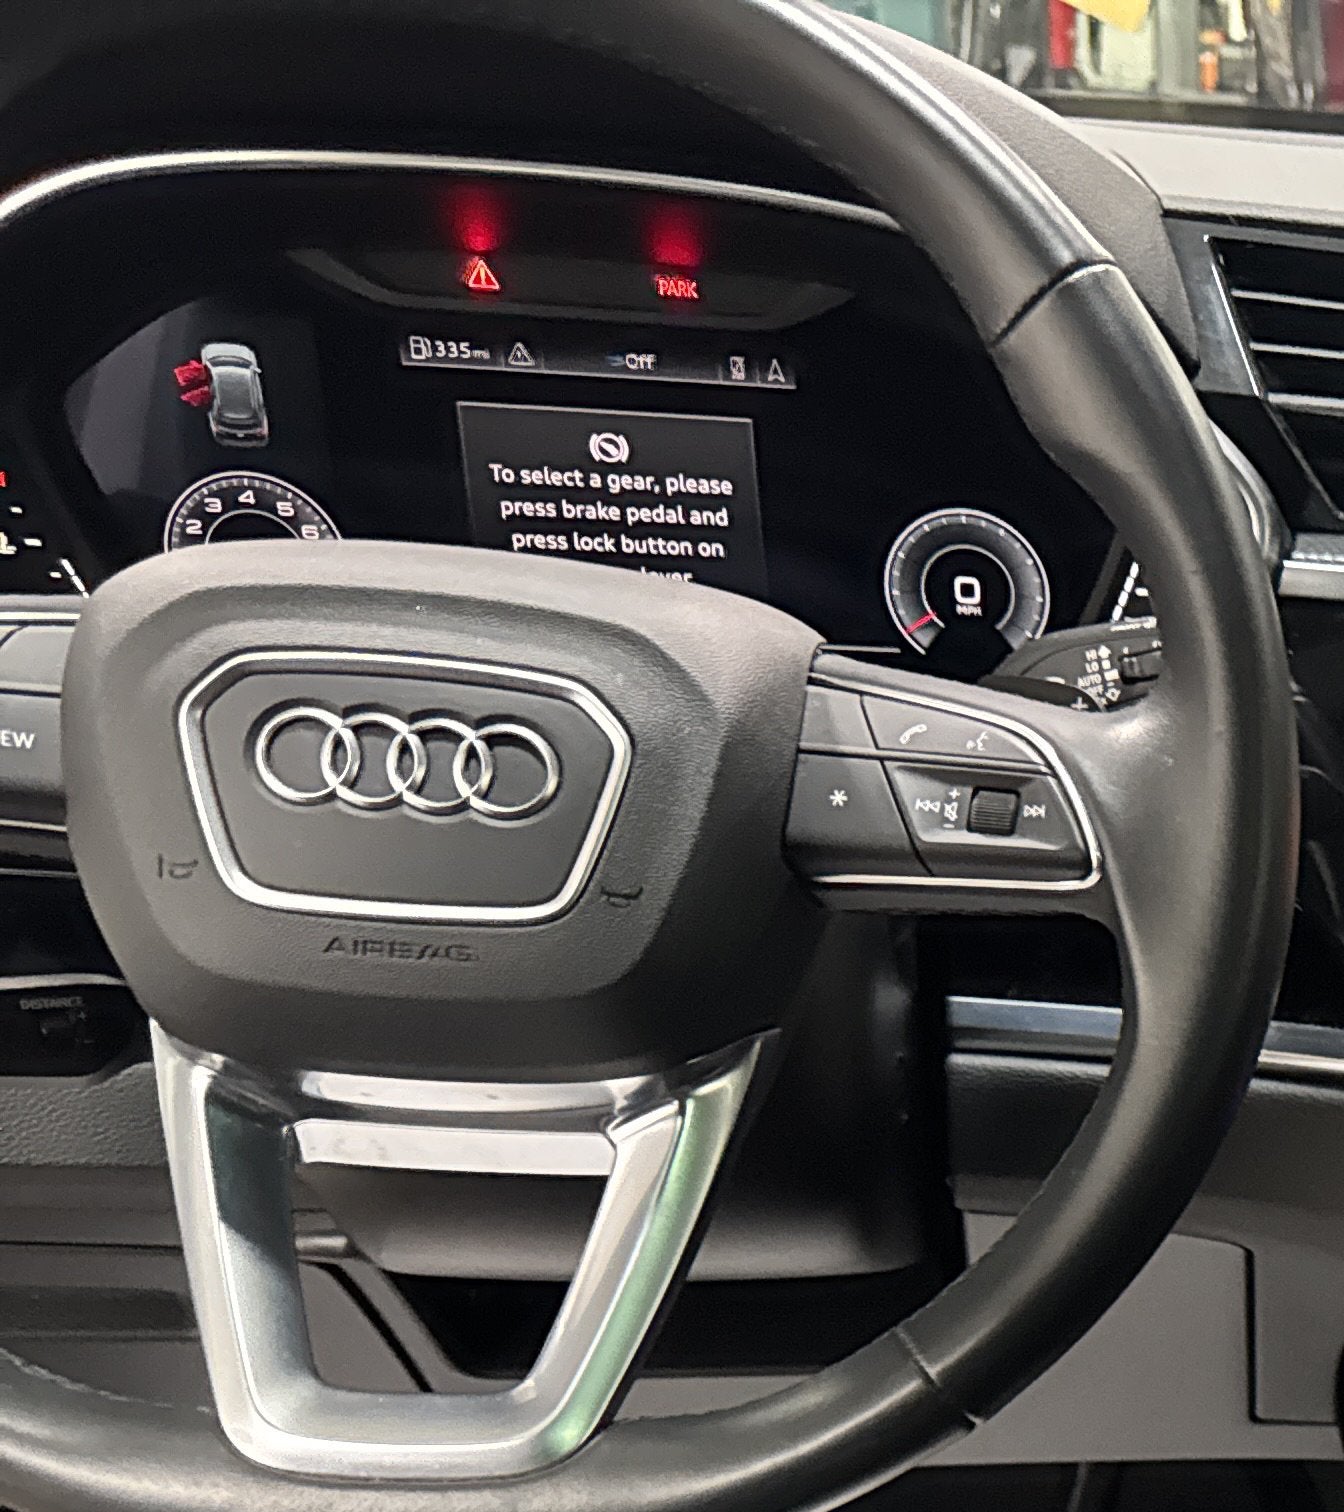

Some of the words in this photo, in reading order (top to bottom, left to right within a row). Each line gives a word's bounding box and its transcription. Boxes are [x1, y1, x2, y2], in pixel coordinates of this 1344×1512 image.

[658, 276, 699, 299] PARK
[625, 353, 657, 371] Off
[489, 464, 514, 483] To
[520, 467, 585, 488] select
[589, 473, 602, 488] a
[607, 474, 660, 494] gear,
[666, 474, 733, 496] please
[204, 497, 222, 513] 3
[238, 489, 256, 505] 4
[276, 501, 294, 517] 5
[500, 500, 557, 520] press
[562, 499, 621, 521] brake
[626, 504, 685, 526] pedal
[689, 508, 728, 527] and
[185, 519, 203, 535] 2
[301, 525, 319, 540] 6
[511, 532, 568, 551] press
[573, 532, 616, 552] lock
[621, 534, 693, 556] button
[697, 540, 725, 558] on
[955, 604, 983, 617] MPH
[1085, 649, 1098, 662] HI
[1085, 661, 1100, 674] LO
[1077, 673, 1102, 688] AUTO
[322, 936, 480, 962] AIRBAG
